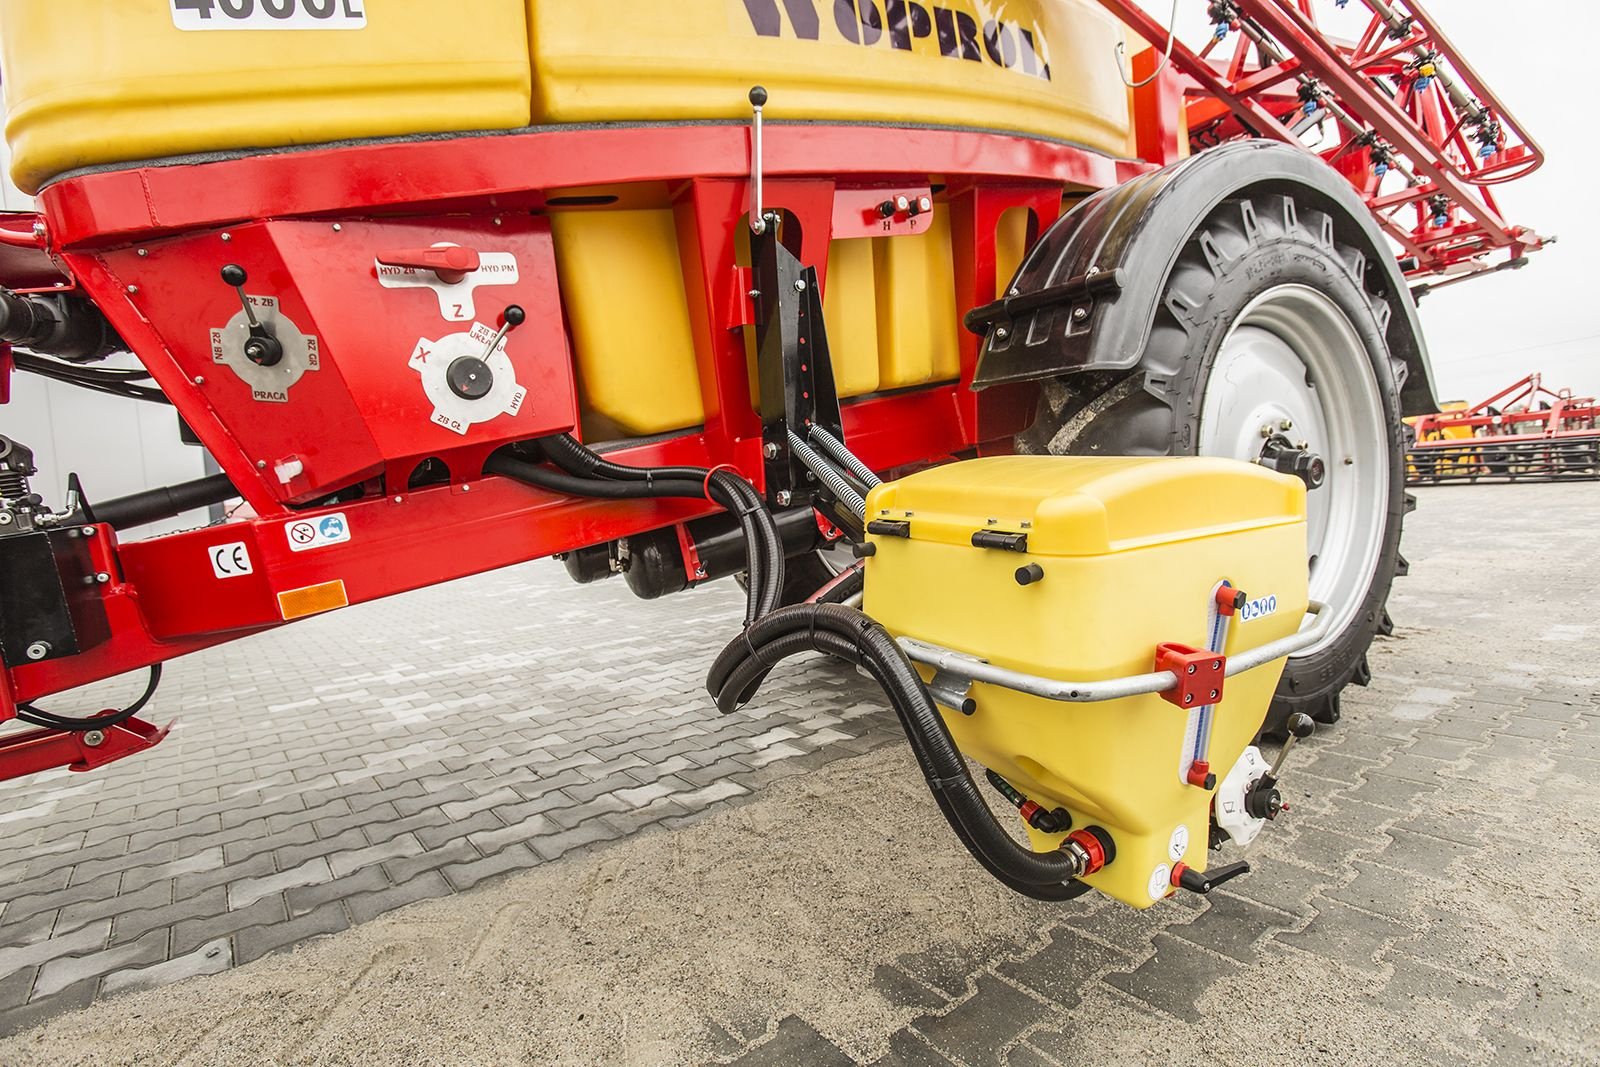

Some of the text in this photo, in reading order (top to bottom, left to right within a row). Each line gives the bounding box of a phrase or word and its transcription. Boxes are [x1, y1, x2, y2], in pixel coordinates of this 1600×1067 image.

[883, 221, 891, 231] H
[910, 219, 917, 229] P
[380, 266, 401, 275] HYD
[481, 264, 515, 273] HYD PM
[261, 298, 274, 307] ZB
[452, 304, 464, 318] Z
[478, 325, 490, 337] ZB
[307, 339, 318, 366] RZ GR
[415, 346, 431, 363] X
[253, 390, 287, 401] PRACA
[510, 392, 523, 410] HYD
[437, 414, 450, 425] ZB
